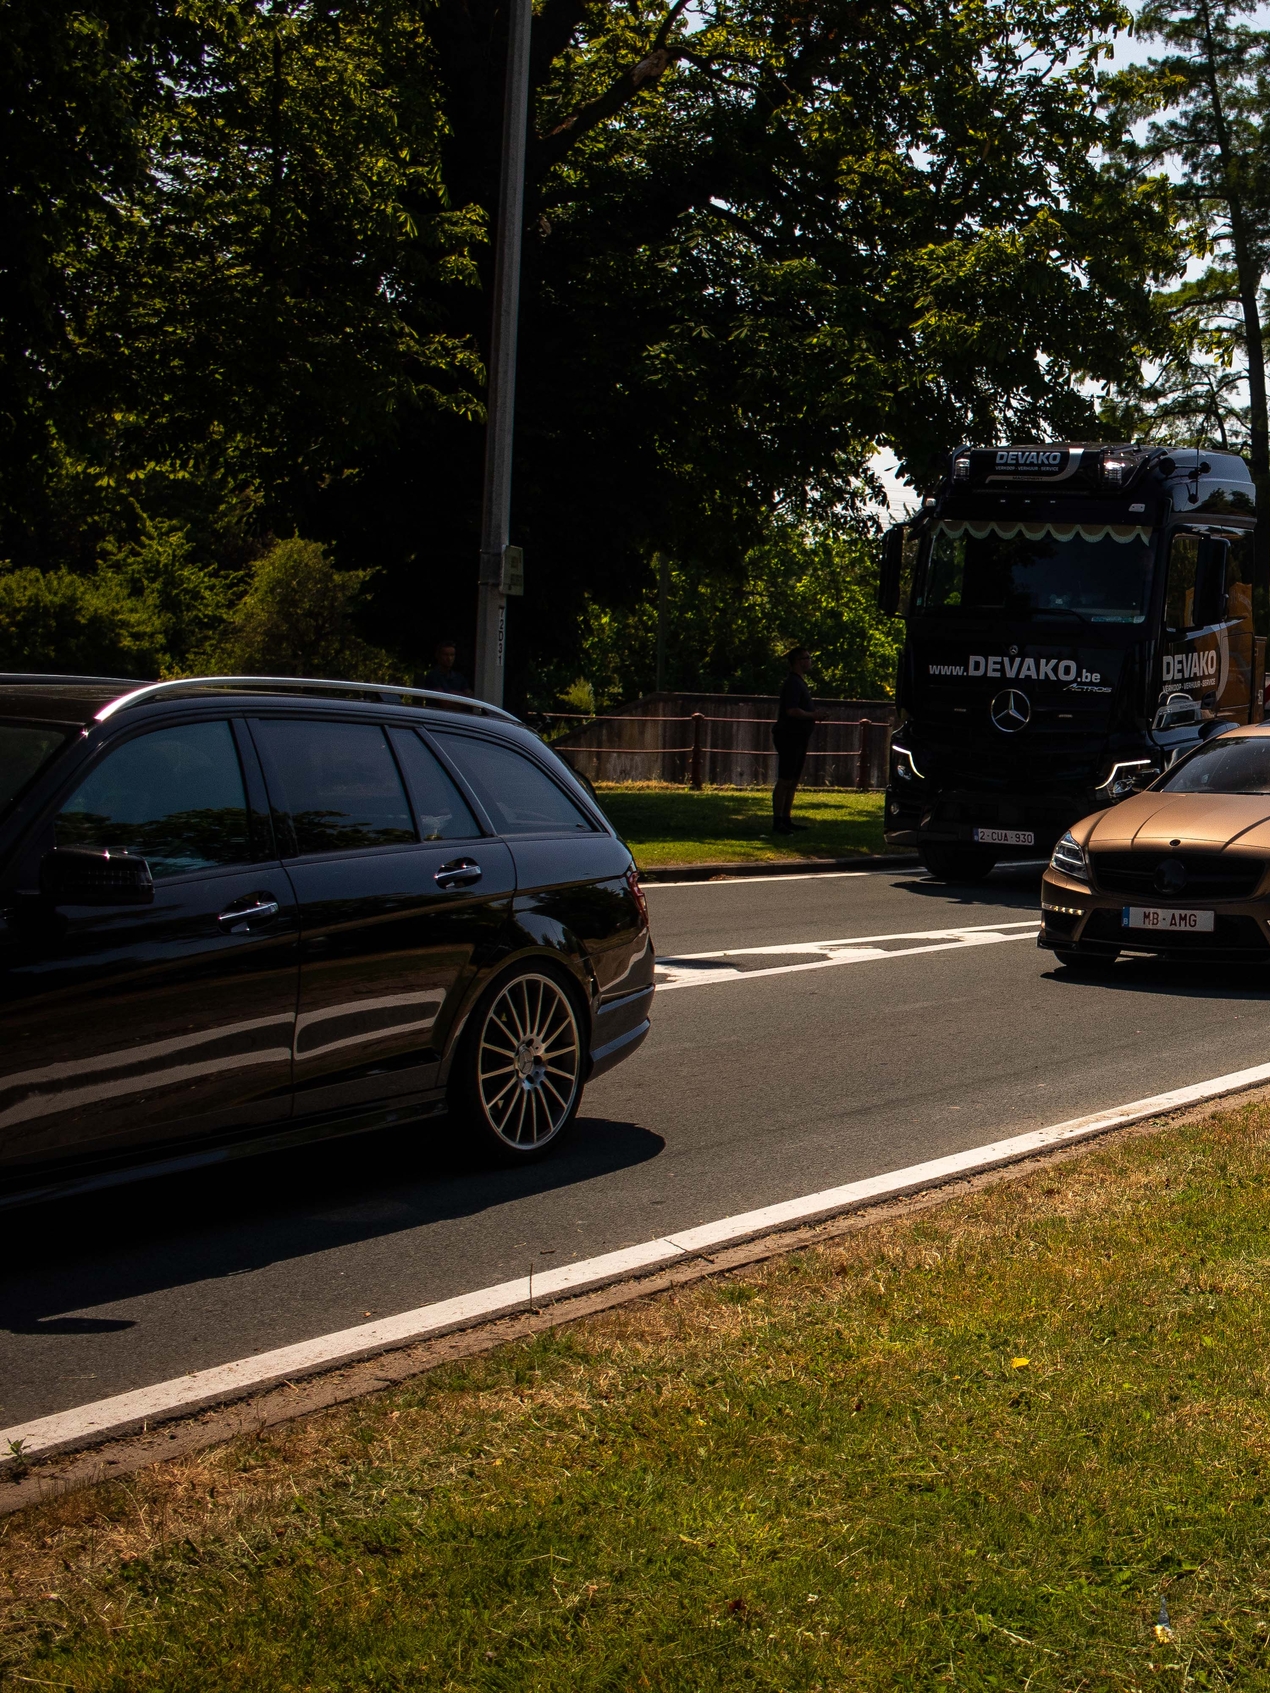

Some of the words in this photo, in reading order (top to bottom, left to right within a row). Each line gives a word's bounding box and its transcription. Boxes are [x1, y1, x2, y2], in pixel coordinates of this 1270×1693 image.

[995, 452, 1061, 465] DEVAKO
[929, 655, 1101, 683] www.DEVAKO.be
[1162, 650, 1217, 681] DEVAKO
[1202, 678, 1216, 687] SERVICE
